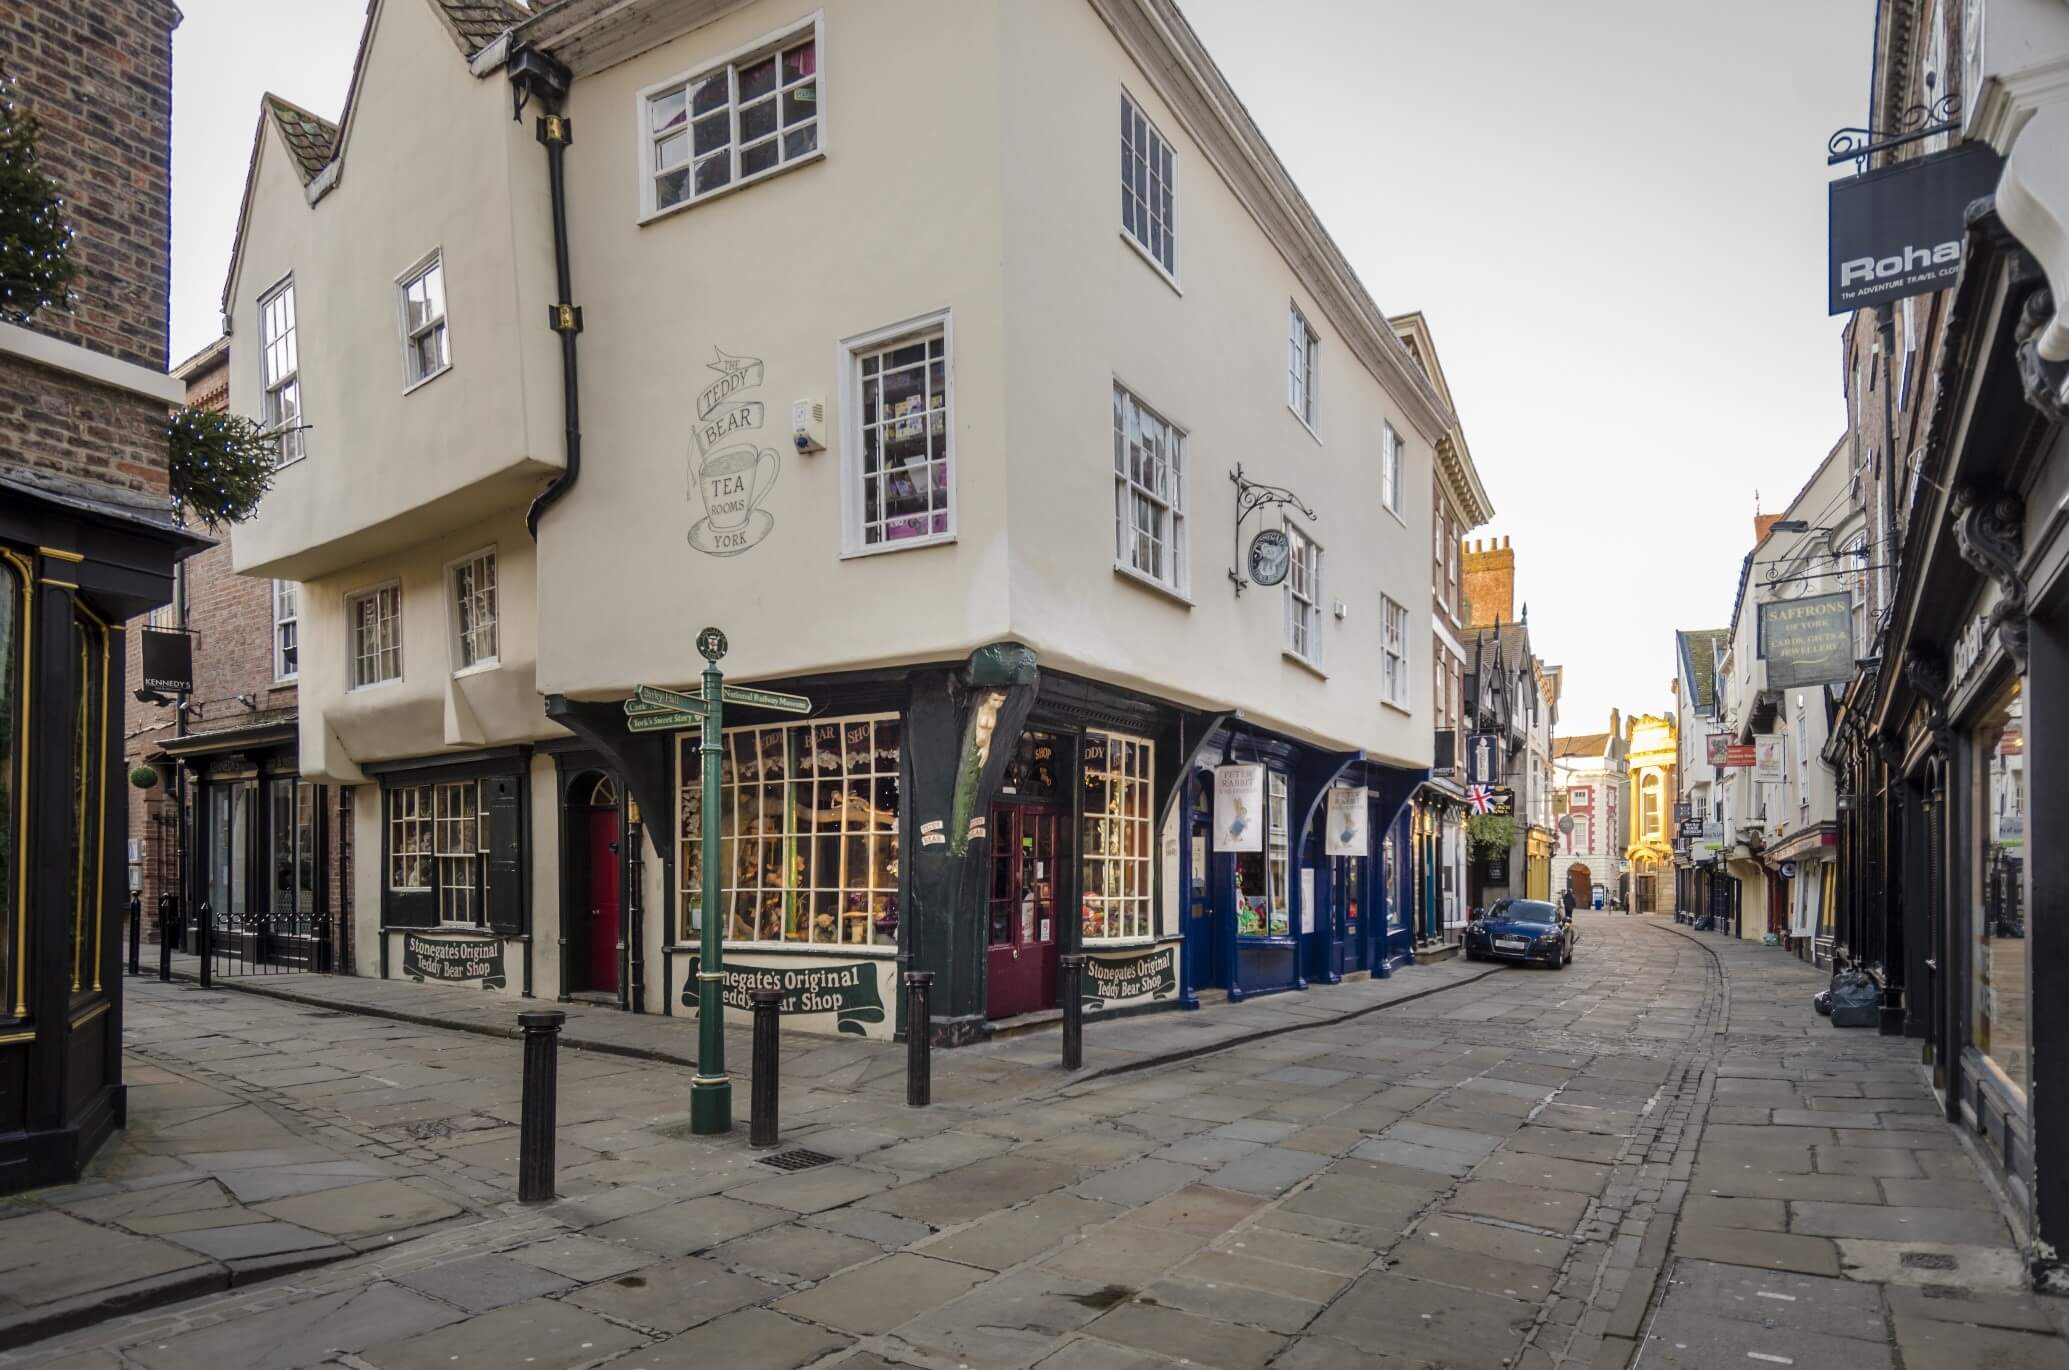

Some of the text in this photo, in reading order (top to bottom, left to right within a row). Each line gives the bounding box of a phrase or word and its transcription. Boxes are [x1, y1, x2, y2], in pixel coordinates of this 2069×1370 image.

[1841, 239, 1965, 287] Roha
[1842, 265, 1961, 300] The ADVENTURE TRAVEL CLOT
[724, 359, 741, 371] THE
[703, 369, 748, 409] TEDDY
[704, 407, 752, 446] BEAR
[711, 475, 745, 497] TEA
[710, 499, 745, 517] ROOMS
[714, 530, 747, 549] YORK
[1769, 601, 1846, 621] SAFFRONS
[724, 689, 752, 701] National
[848, 722, 877, 745] SHO
[1084, 747, 1105, 760] DDY
[409, 938, 498, 961] Stonegate's Original
[417, 955, 490, 978] Teddy Bear Shop
[1088, 952, 1170, 984] Stonegate's Original
[722, 966, 860, 992] negate's Original
[1097, 975, 1162, 999] Teddy Bear Shop
[722, 990, 752, 1010] eddy
[801, 991, 843, 1011] Shop
